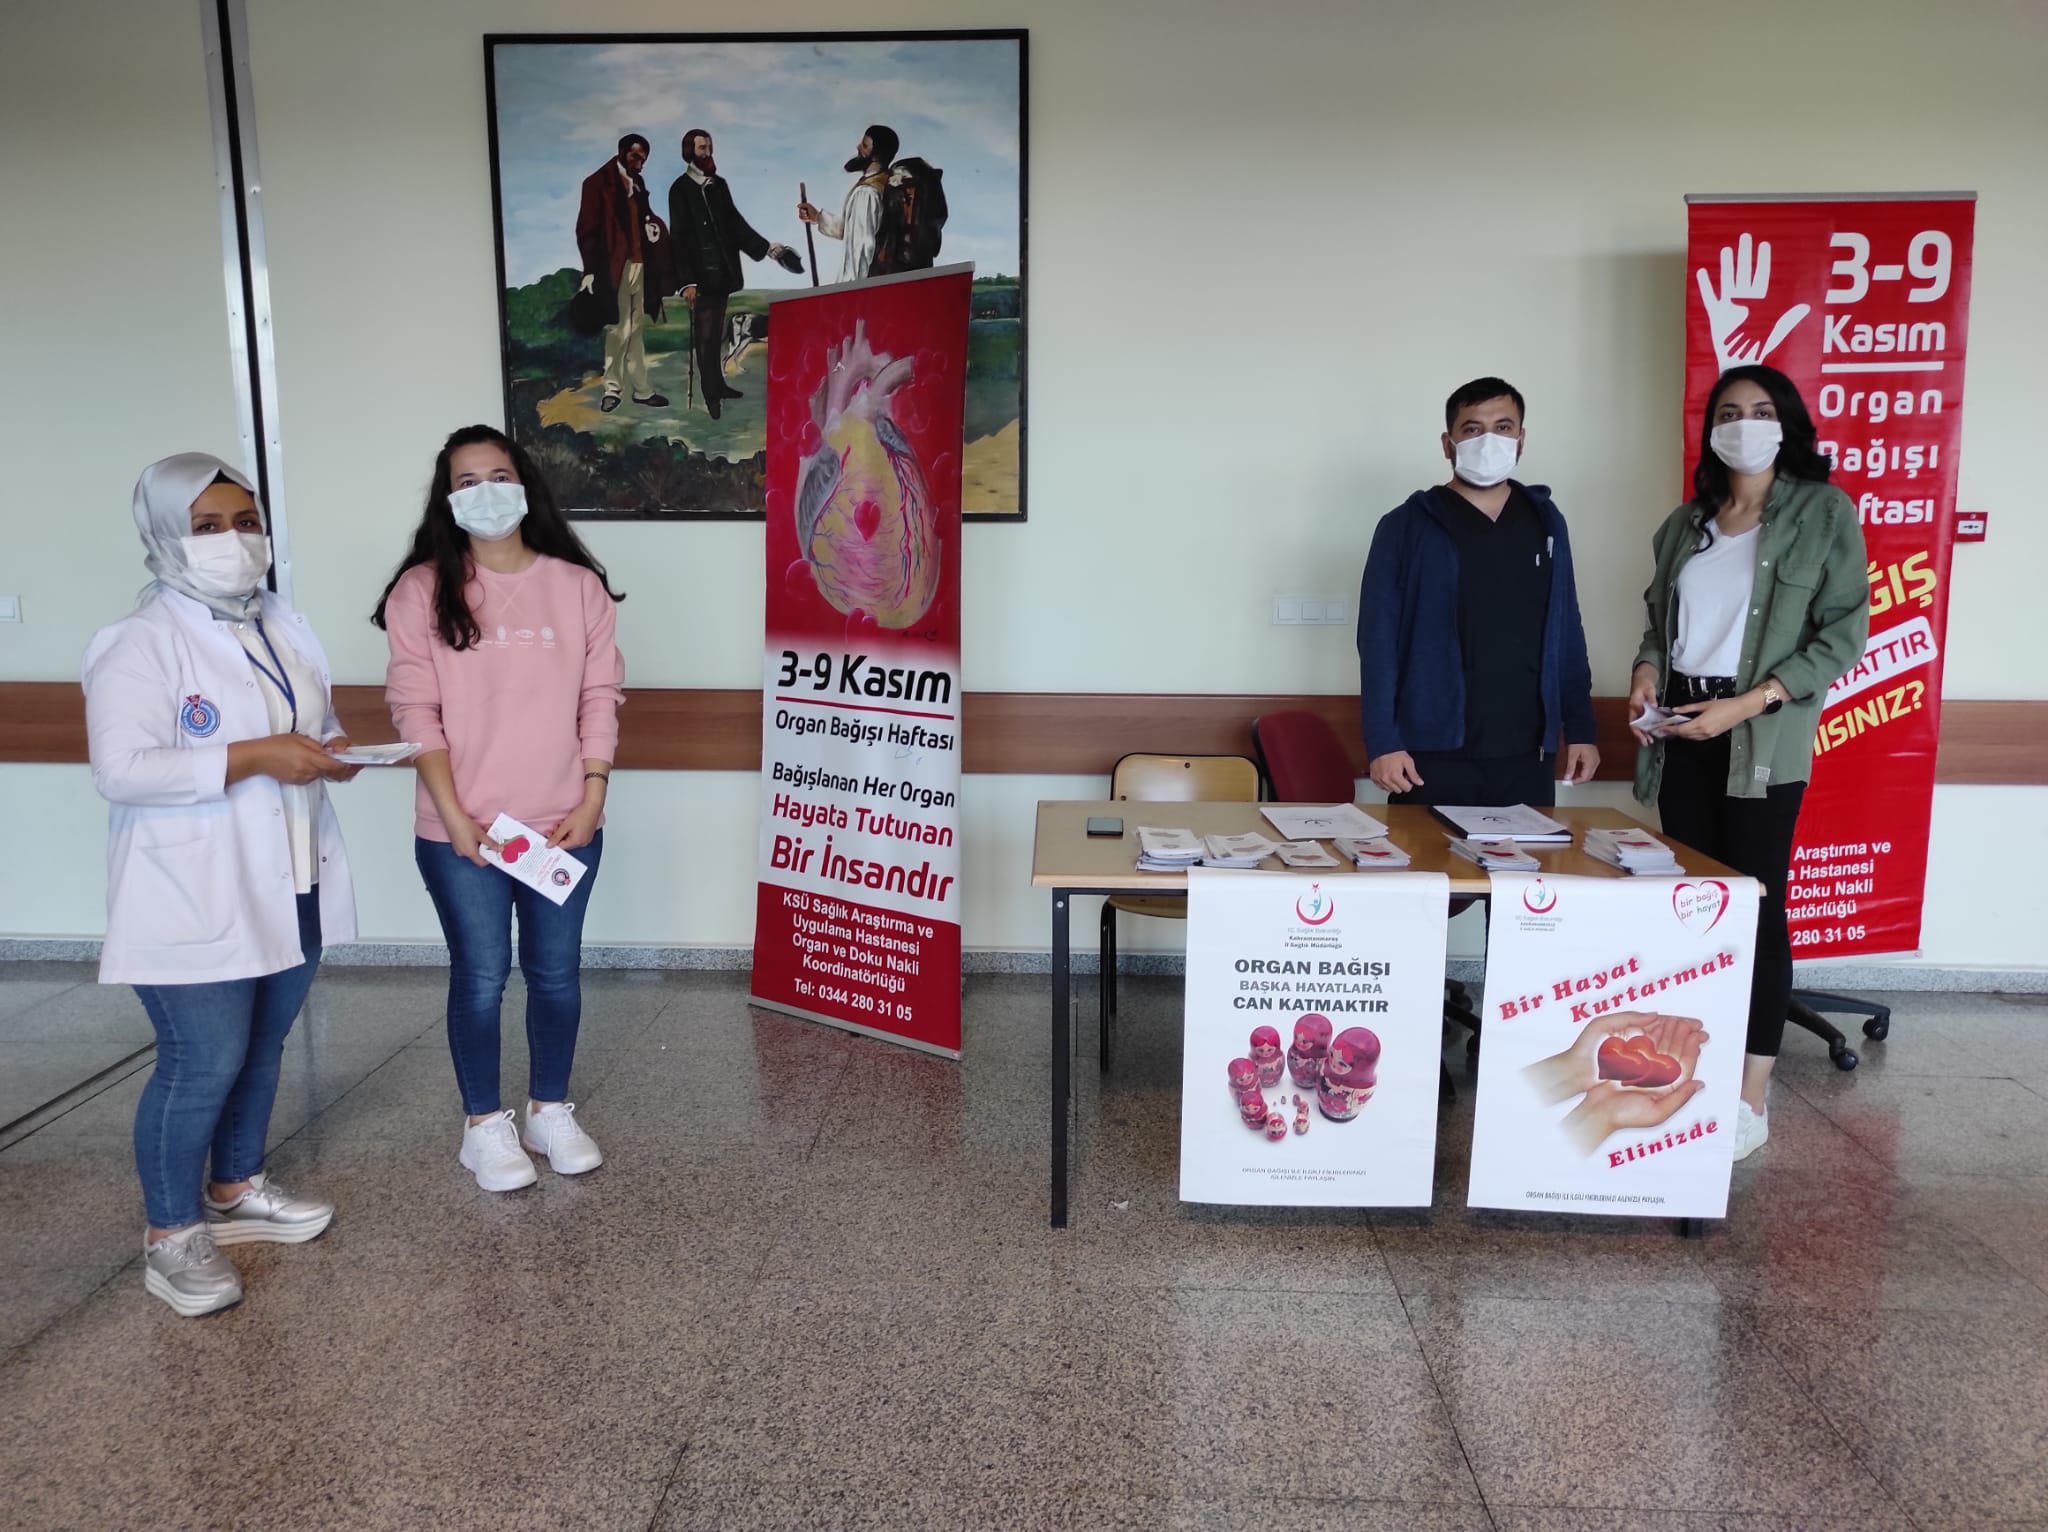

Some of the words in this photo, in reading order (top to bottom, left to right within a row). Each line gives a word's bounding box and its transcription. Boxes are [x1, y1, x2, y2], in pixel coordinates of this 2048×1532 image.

[1824, 230, 1953, 304] 3-9
[1822, 314, 1946, 353] Kasım
[1819, 384, 1942, 423] Organ
[1817, 439, 1939, 478] Bağışı
[1853, 492, 1934, 526] ftası
[1866, 550, 1937, 616] ĞIŞ
[778, 650, 832, 690] 3-9
[840, 654, 952, 703] Kasım
[776, 710, 826, 735] Organ
[830, 716, 883, 747] Bağışı
[887, 723, 954, 751] Haftası
[1813, 680, 1925, 757] ISINIZ?
[772, 762, 858, 793] Bağışlanan
[863, 776, 896, 798] Her
[900, 781, 955, 808] Organ
[772, 793, 848, 828] Hayata
[855, 807, 953, 847] Tutunan
[770, 835, 815, 873] Bir
[820, 835, 954, 901] İnsandır
[1794, 840, 1867, 862] Araştırma
[1872, 840, 1891, 854] ve
[1799, 859, 1875, 880] Hastanesi
[1785, 900, 1857, 919] natörlüğü
[1790, 884, 1830, 900] Doku
[1834, 879, 1873, 896] Nakli
[783, 892, 810, 909] KSÜ
[813, 898, 849, 920] Sağlık
[850, 908, 914, 935] Araştırma
[917, 924, 933, 939] ve
[793, 913, 852, 940] Uygulama
[855, 928, 920, 956] Hastanesi
[1792, 929, 1820, 946] 280
[1825, 927, 1841, 943] 31
[1847, 925, 1866, 941] 05
[792, 933, 829, 954] Organ
[833, 945, 847, 958] ve
[849, 947, 883, 967] Doku
[886, 954, 919, 976] Nakli
[802, 954, 905, 994] Koordinatörlüğü
[1234, 959, 1311, 975] ORGAN
[1318, 957, 1391, 980] BAĞIŞI
[794, 978, 815, 997] Tel:
[818, 985, 848, 1005] 0344
[851, 993, 874, 1011] 280
[877, 999, 892, 1016] 31
[896, 1004, 912, 1022] 05
[1233, 996, 1273, 1011] CAN
[1278, 998, 1389, 1013] KATMAKTIR
[1239, 980, 1291, 995] BAŞKA
[1296, 981, 1383, 995] HAYATLARA
[1499, 995, 1545, 1021] Bir
[1552, 957, 1641, 1002] Hayat
[1570, 951, 1736, 1023] Kurtarmak
[1607, 1119, 1719, 1168] Elinizde
